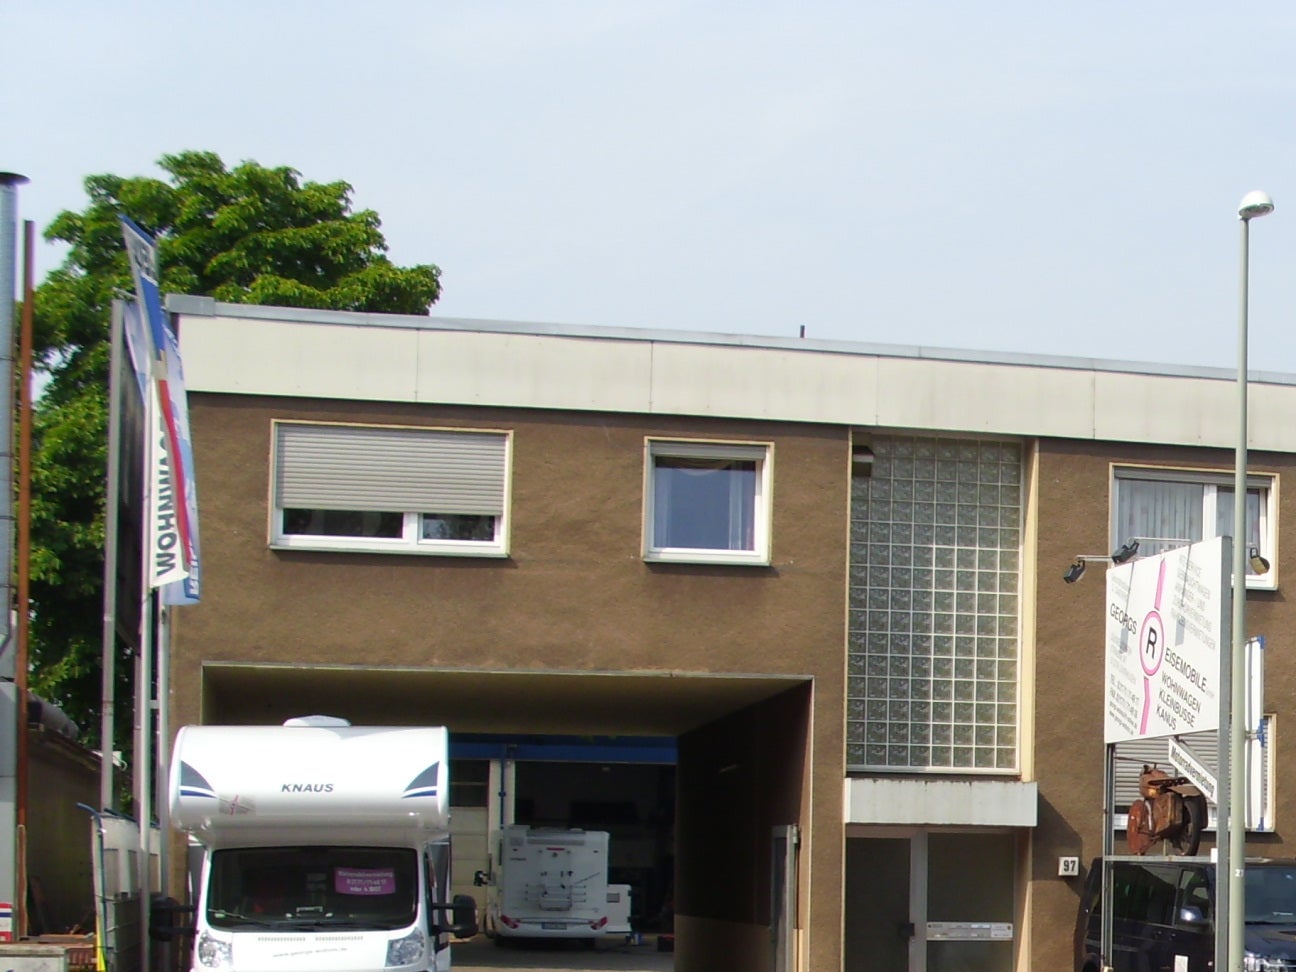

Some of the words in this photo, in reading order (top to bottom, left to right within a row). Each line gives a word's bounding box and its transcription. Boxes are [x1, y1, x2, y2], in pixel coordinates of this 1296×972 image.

[1110, 603, 1137, 635] GEORGS
[1146, 626, 1157, 659] R
[1165, 648, 1207, 693] EISEMOBILE
[1162, 670, 1201, 714] WOHNWAGEN
[1157, 704, 1176, 730] KANUS
[1159, 690, 1196, 728] KLEINBUSSE
[281, 783, 334, 793] KNAUS
[1063, 860, 1076, 872] 97
